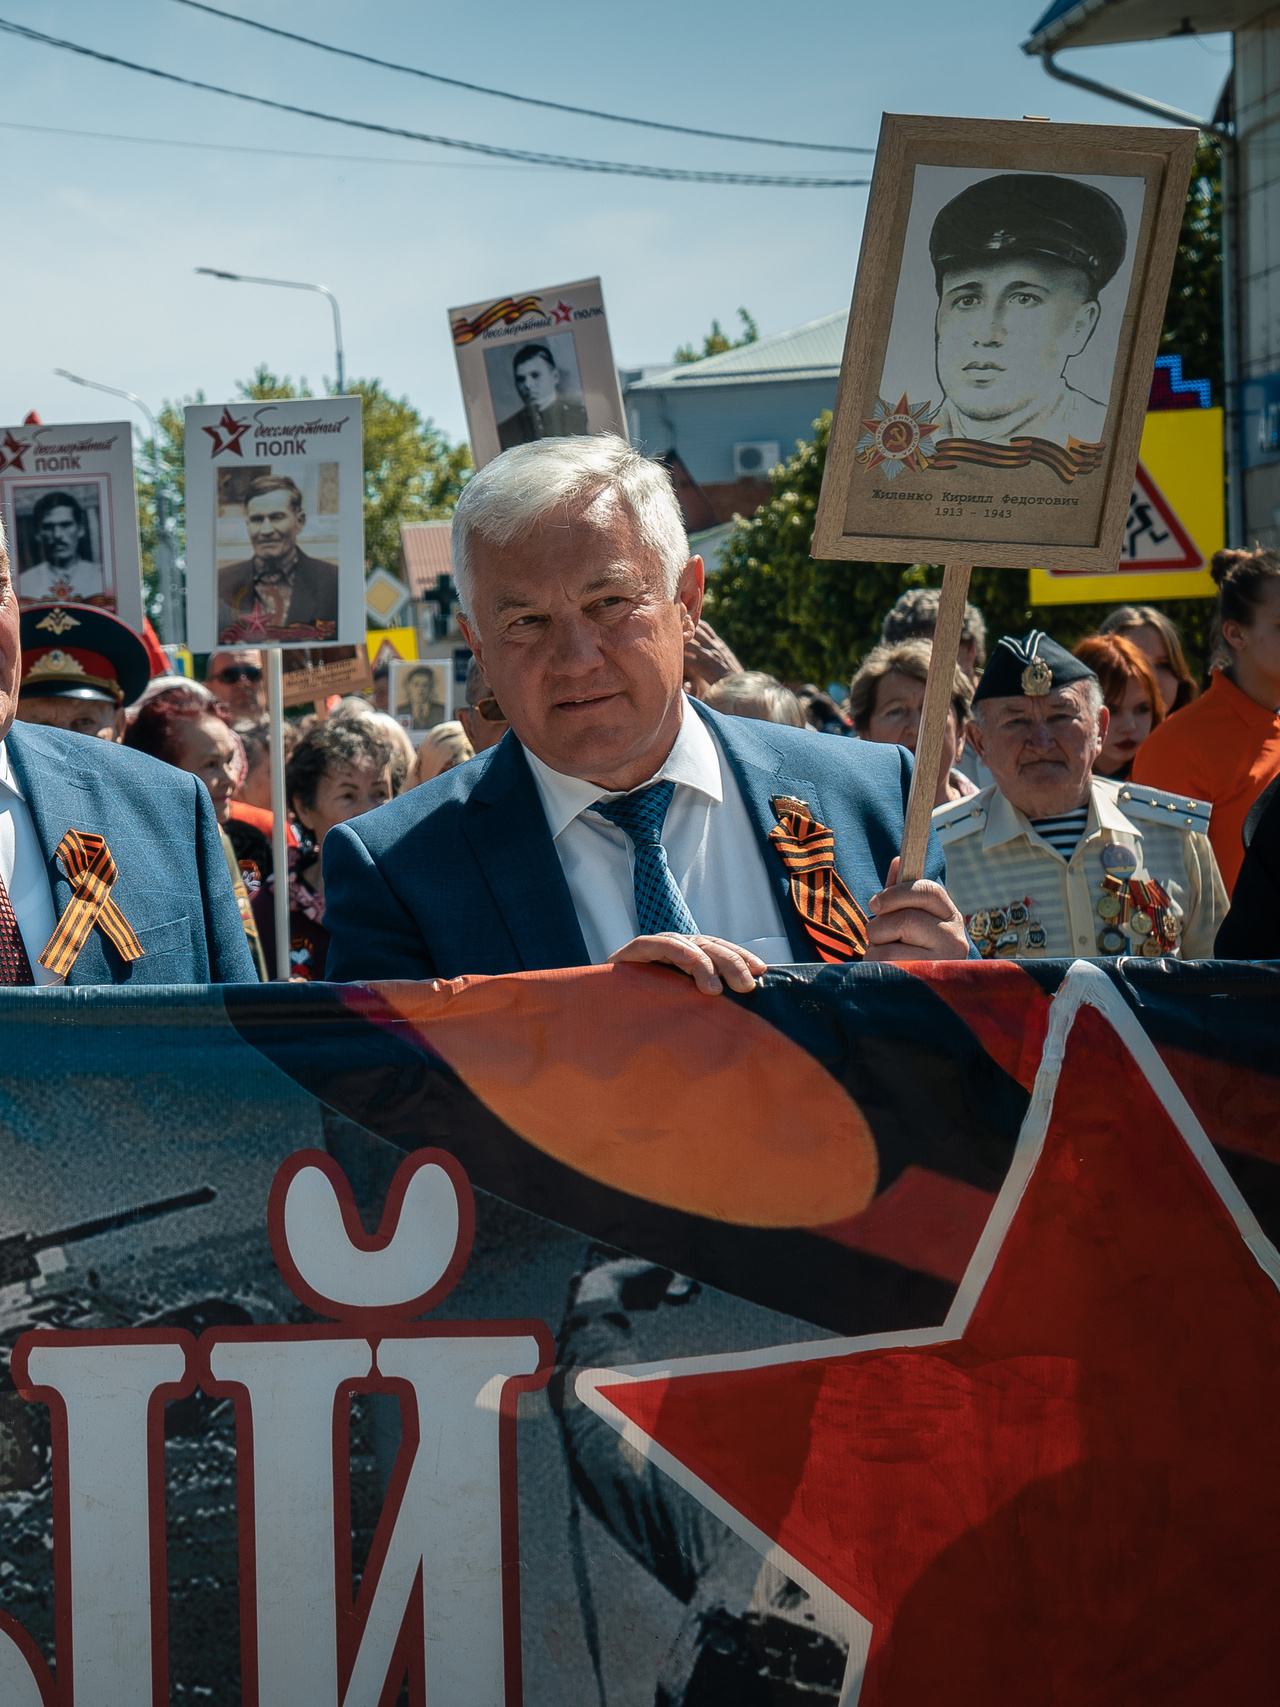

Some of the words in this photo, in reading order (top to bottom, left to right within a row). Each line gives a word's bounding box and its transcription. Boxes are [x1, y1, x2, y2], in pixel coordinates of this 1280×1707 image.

[255, 439, 307, 457] ПОЛК
[34, 456, 81, 472] ПОЛК
[872, 489, 933, 501] Жиленко
[941, 491, 994, 505] Кирилл
[1002, 494, 1080, 506] Федотович
[934, 507, 963, 517] 1913
[984, 508, 1012, 519] 1943
